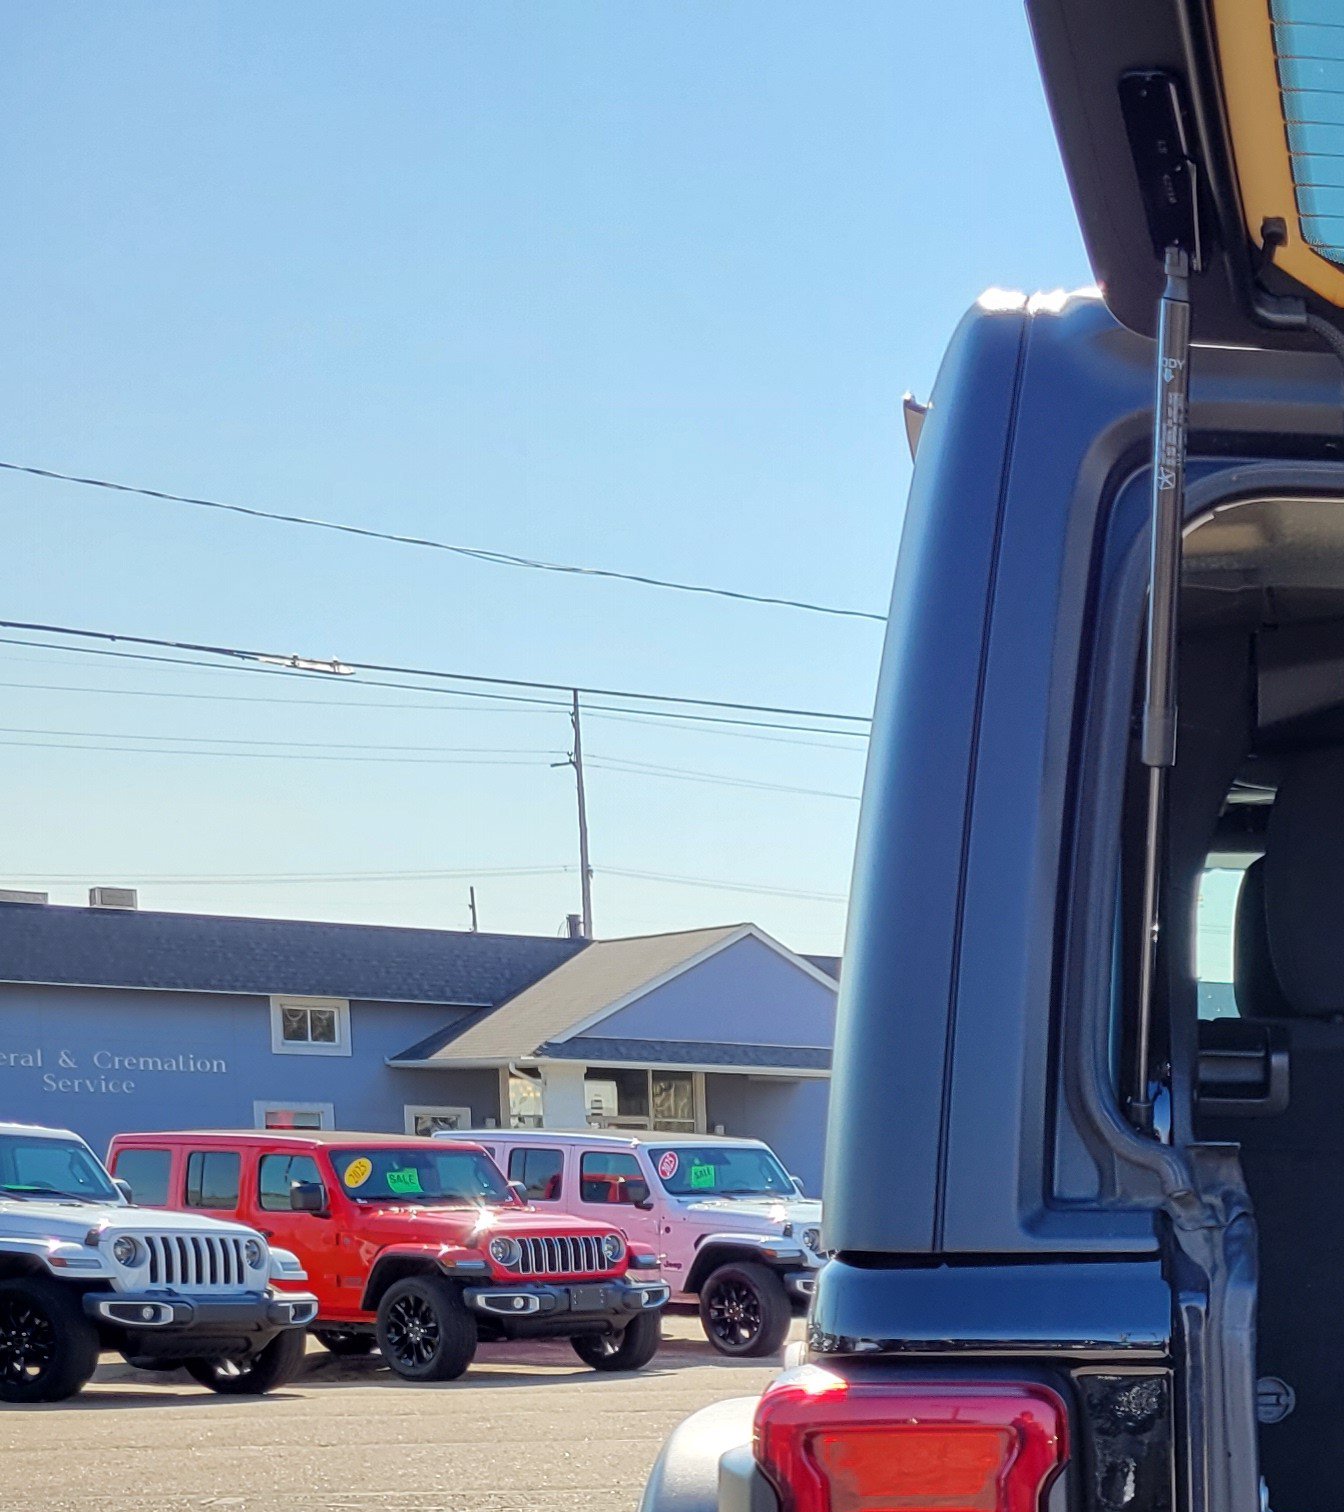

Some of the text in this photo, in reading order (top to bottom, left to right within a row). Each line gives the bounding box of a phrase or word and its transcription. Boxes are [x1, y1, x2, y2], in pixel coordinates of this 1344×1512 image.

[58, 1050, 78, 1069] &
[93, 1050, 228, 1073] Cremation
[42, 1073, 136, 1094] Service
[388, 1173, 416, 1185] SALE
